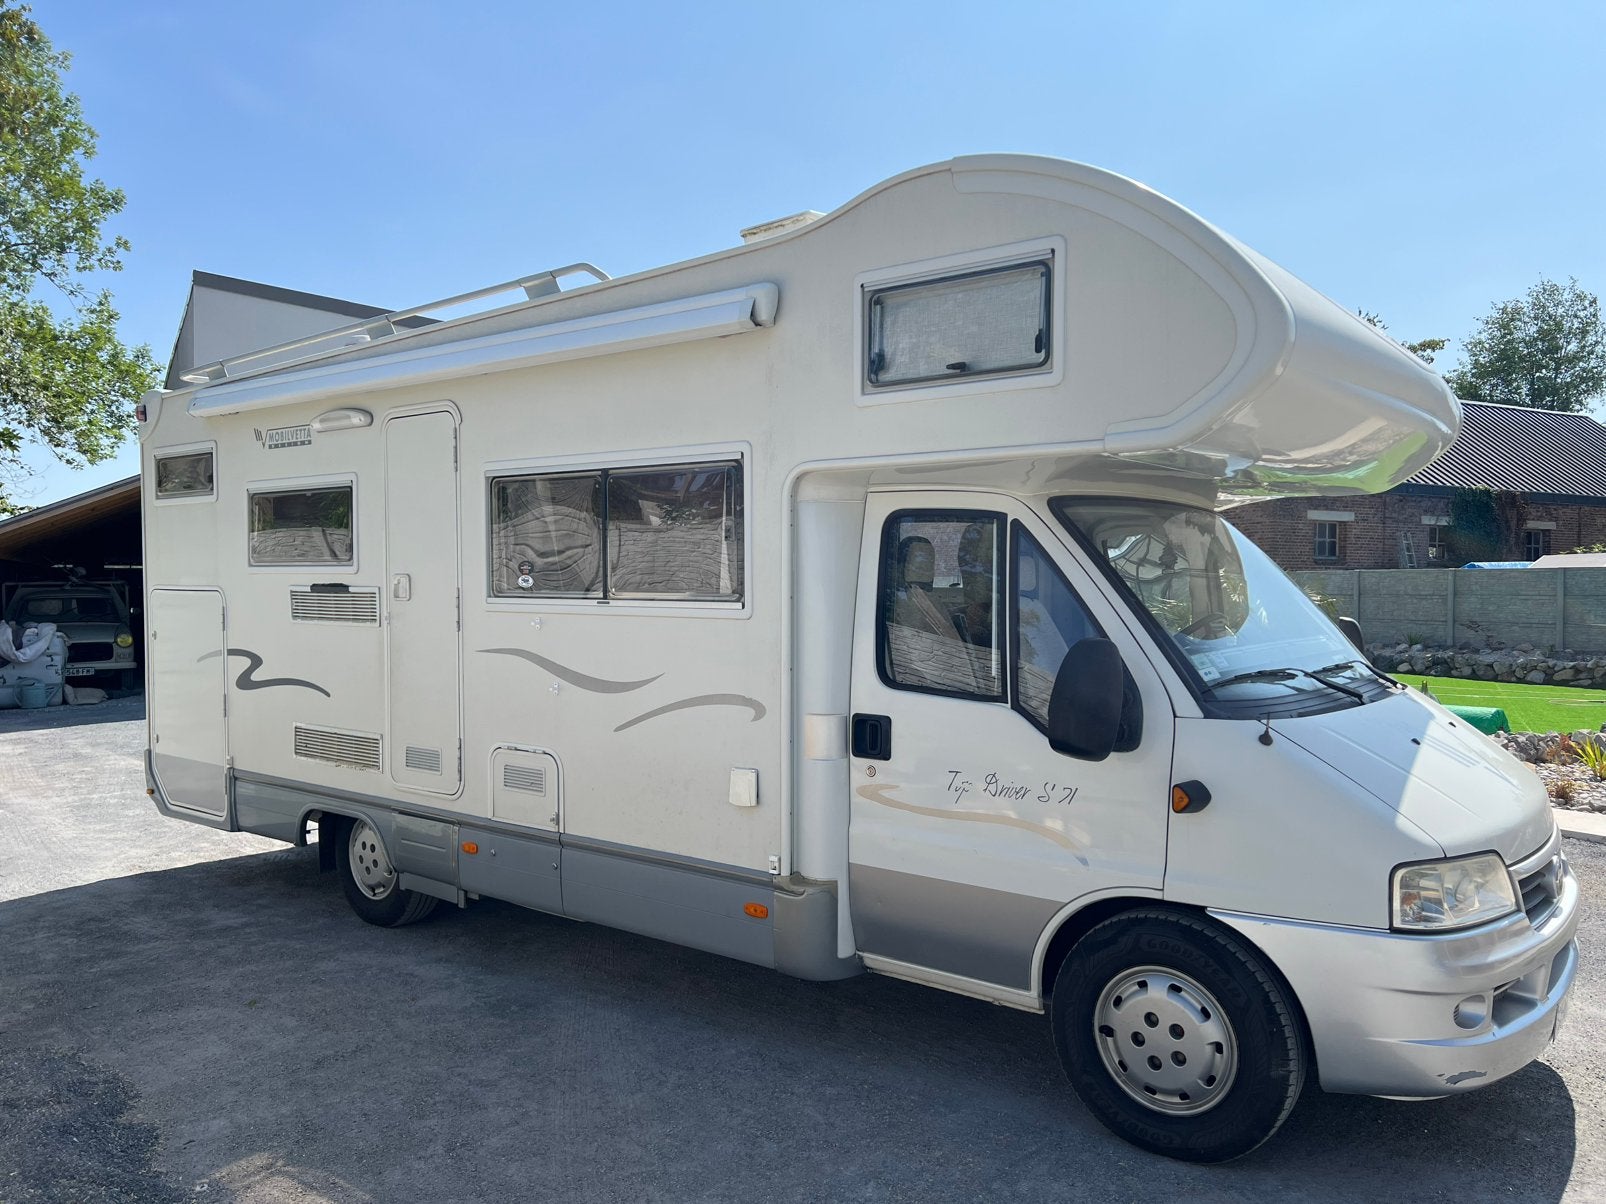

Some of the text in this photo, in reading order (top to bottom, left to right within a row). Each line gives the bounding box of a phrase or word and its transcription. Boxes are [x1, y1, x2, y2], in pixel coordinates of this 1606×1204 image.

[268, 427, 312, 443] MOBILVETTA
[983, 772, 1031, 800] Driver
[1147, 937, 1243, 1000] GOODYEAR
